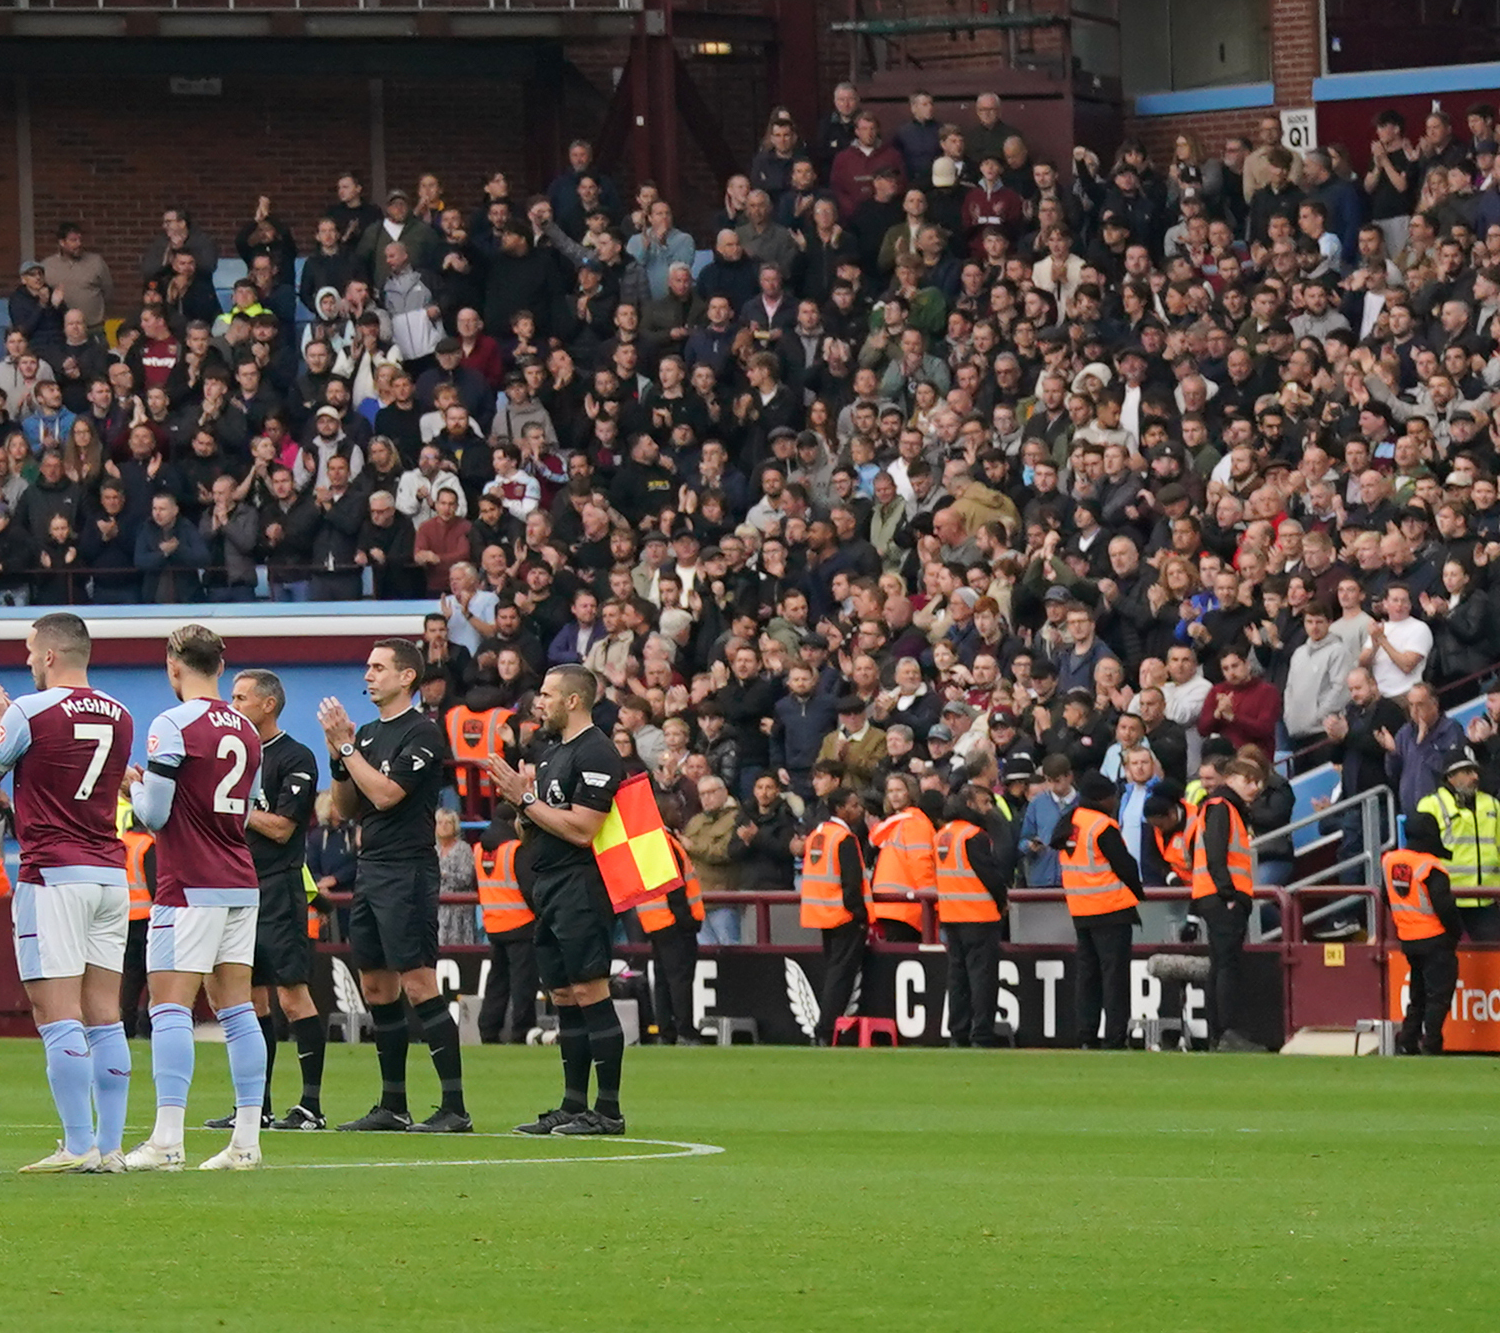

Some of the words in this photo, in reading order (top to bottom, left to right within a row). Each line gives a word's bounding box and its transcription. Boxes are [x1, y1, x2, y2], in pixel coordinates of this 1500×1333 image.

[1290, 127, 1309, 147] Q1
[60, 698, 123, 722] McGINN
[208, 711, 242, 731] CASH
[74, 723, 114, 801] 7
[213, 734, 248, 815] 2
[896, 960, 1208, 1039] CSTRE
